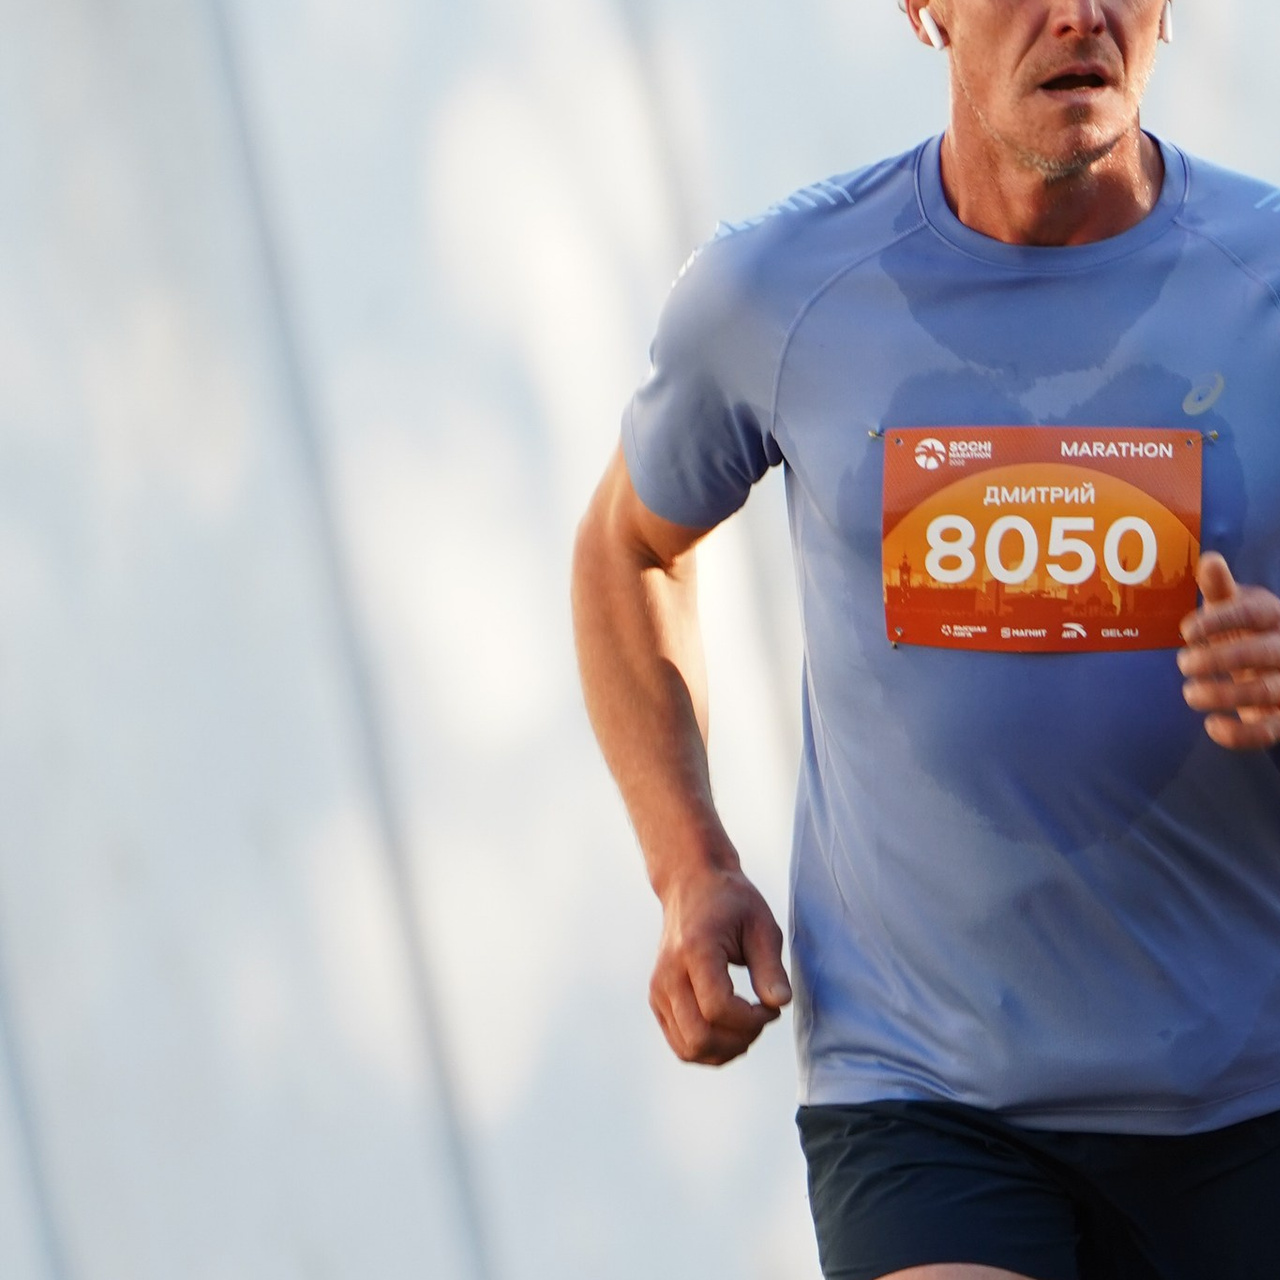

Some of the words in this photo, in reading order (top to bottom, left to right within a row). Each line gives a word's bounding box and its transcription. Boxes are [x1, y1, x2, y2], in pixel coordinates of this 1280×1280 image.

[1061, 441, 1173, 458] MARATHON
[983, 482, 1095, 506] ДМИТРИЙ
[925, 514, 1158, 585] 8050
